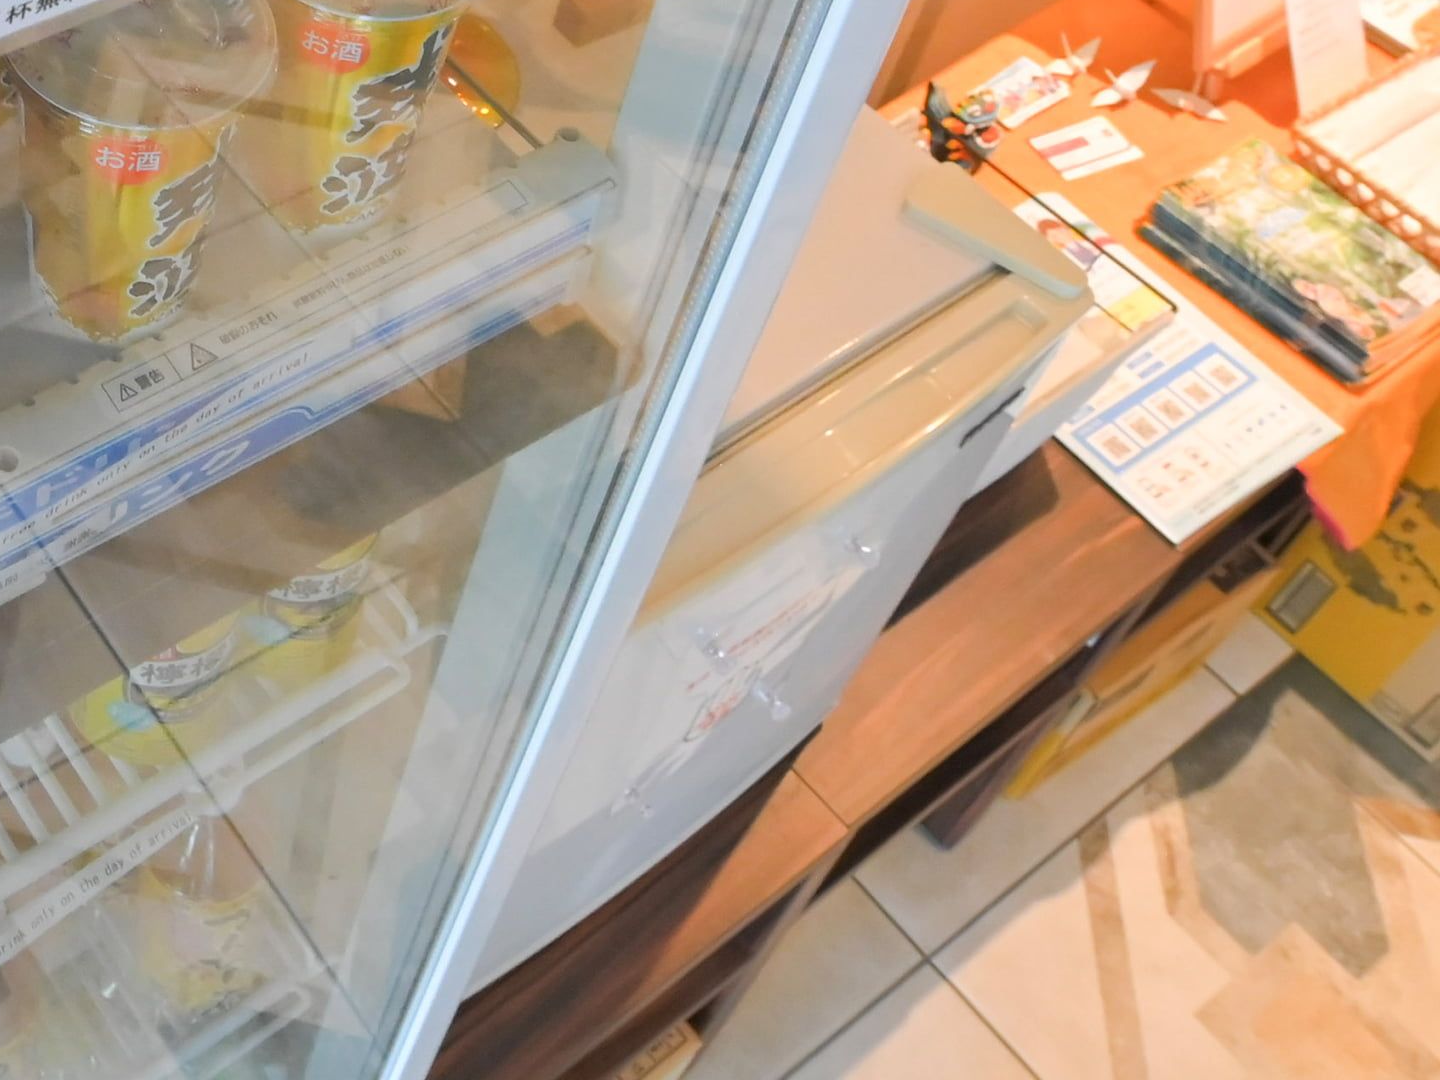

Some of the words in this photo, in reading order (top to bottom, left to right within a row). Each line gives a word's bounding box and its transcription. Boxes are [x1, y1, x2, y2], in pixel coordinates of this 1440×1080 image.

[302, 29, 363, 63] お酒
[95, 146, 161, 172] お酒
[196, 405, 220, 430] day
[31, 905, 56, 930] only
[60, 891, 75, 907] on
[79, 874, 100, 894] the
[104, 857, 126, 878] day
[129, 843, 143, 860] of
